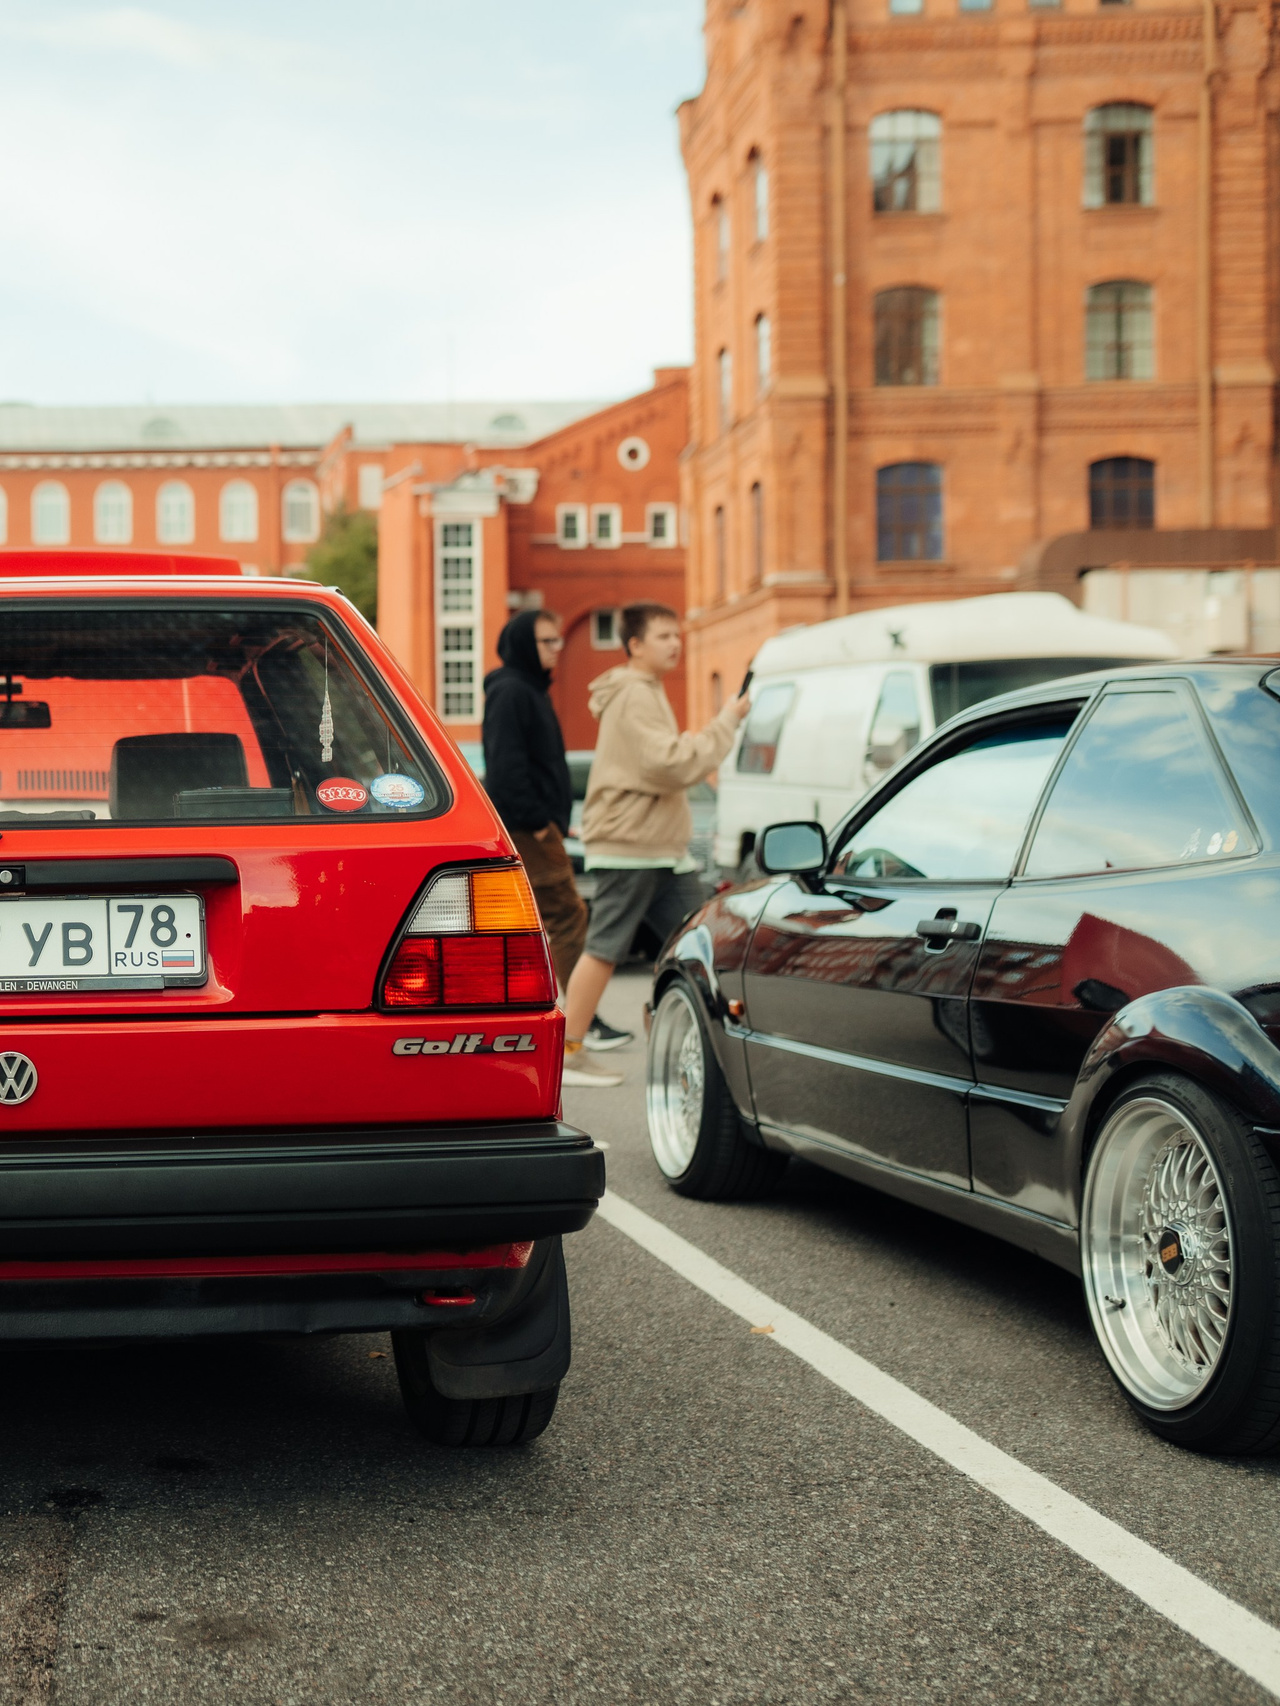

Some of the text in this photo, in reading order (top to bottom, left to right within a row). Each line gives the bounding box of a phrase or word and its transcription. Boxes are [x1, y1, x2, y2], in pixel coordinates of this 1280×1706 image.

[117, 904, 178, 948] 78
[115, 951, 159, 967] RUS
[26, 980, 79, 991] DEWANGEN
[392, 1033, 538, 1056] Golf CL
